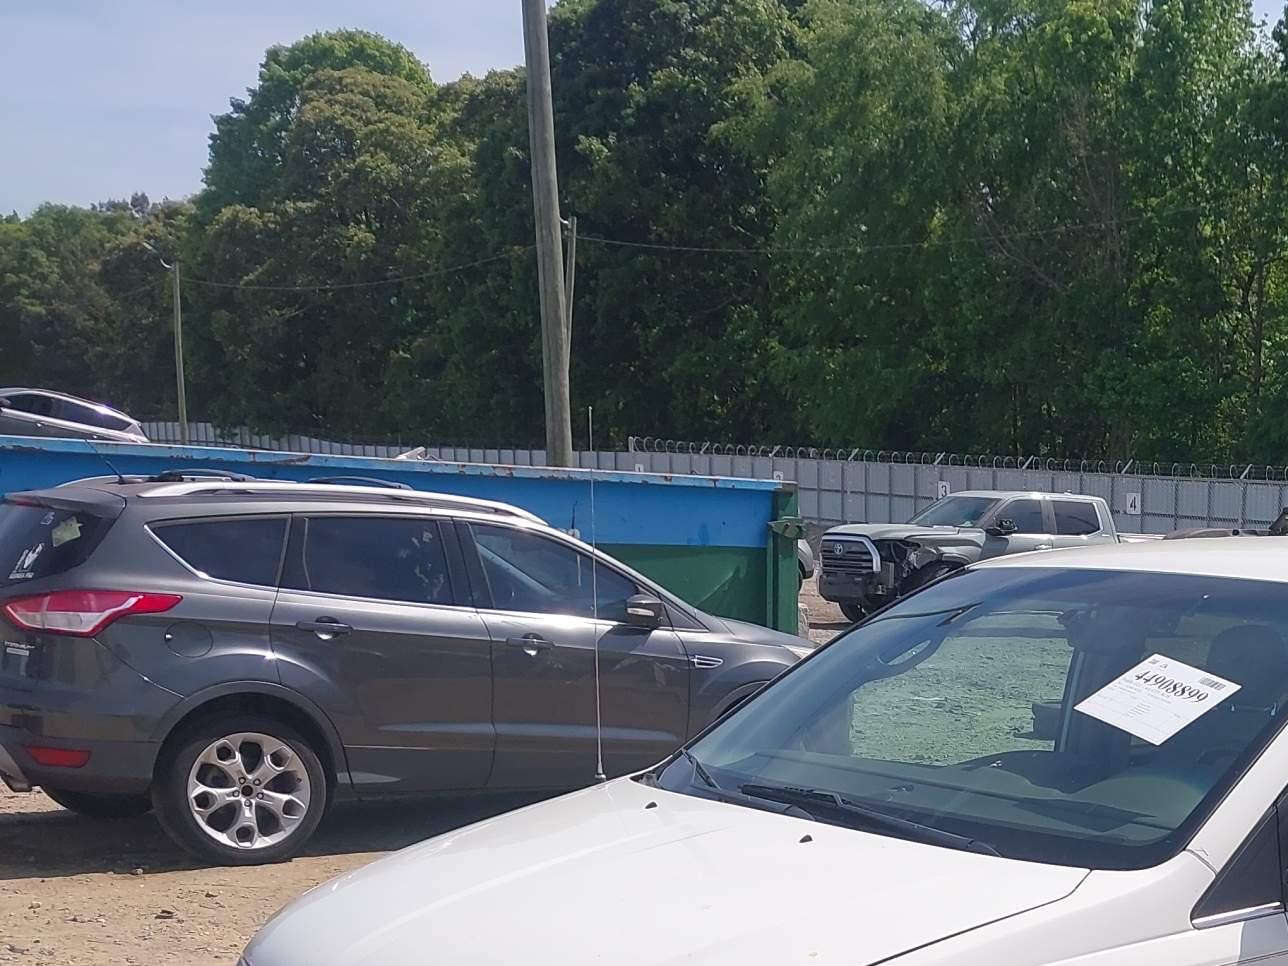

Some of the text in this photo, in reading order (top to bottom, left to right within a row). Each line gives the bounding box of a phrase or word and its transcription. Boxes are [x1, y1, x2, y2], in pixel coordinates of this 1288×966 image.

[941, 485, 947, 497] 3
[1130, 495, 1136, 512] 4
[1135, 670, 1209, 703] 44908899
